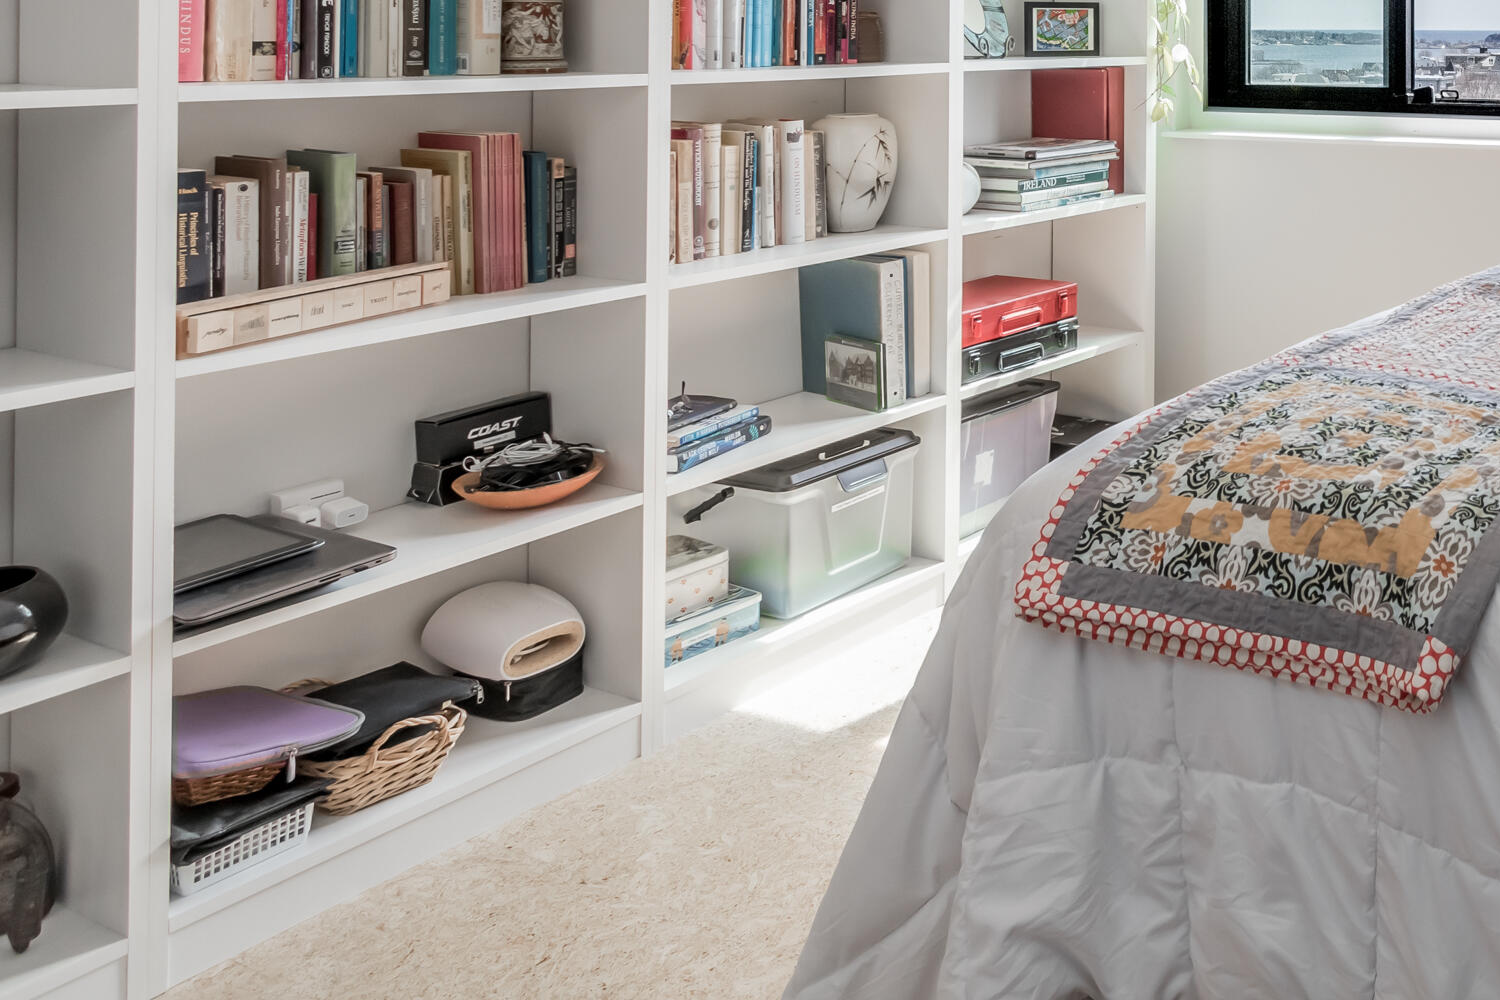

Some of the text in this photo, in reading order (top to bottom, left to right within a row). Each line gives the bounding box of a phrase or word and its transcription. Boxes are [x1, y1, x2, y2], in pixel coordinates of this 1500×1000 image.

[323, 13, 331, 32] TREVOR
[793, 157, 801, 216] ON HINDUISM
[1023, 176, 1057, 191] IRELAND
[189, 212, 200, 256] Principles of
[297, 217, 307, 256] Metaphors
[177, 213, 189, 288] Historical Linguistics
[298, 257, 305, 266] We
[297, 268, 305, 283] Live
[466, 415, 523, 440] COAST
